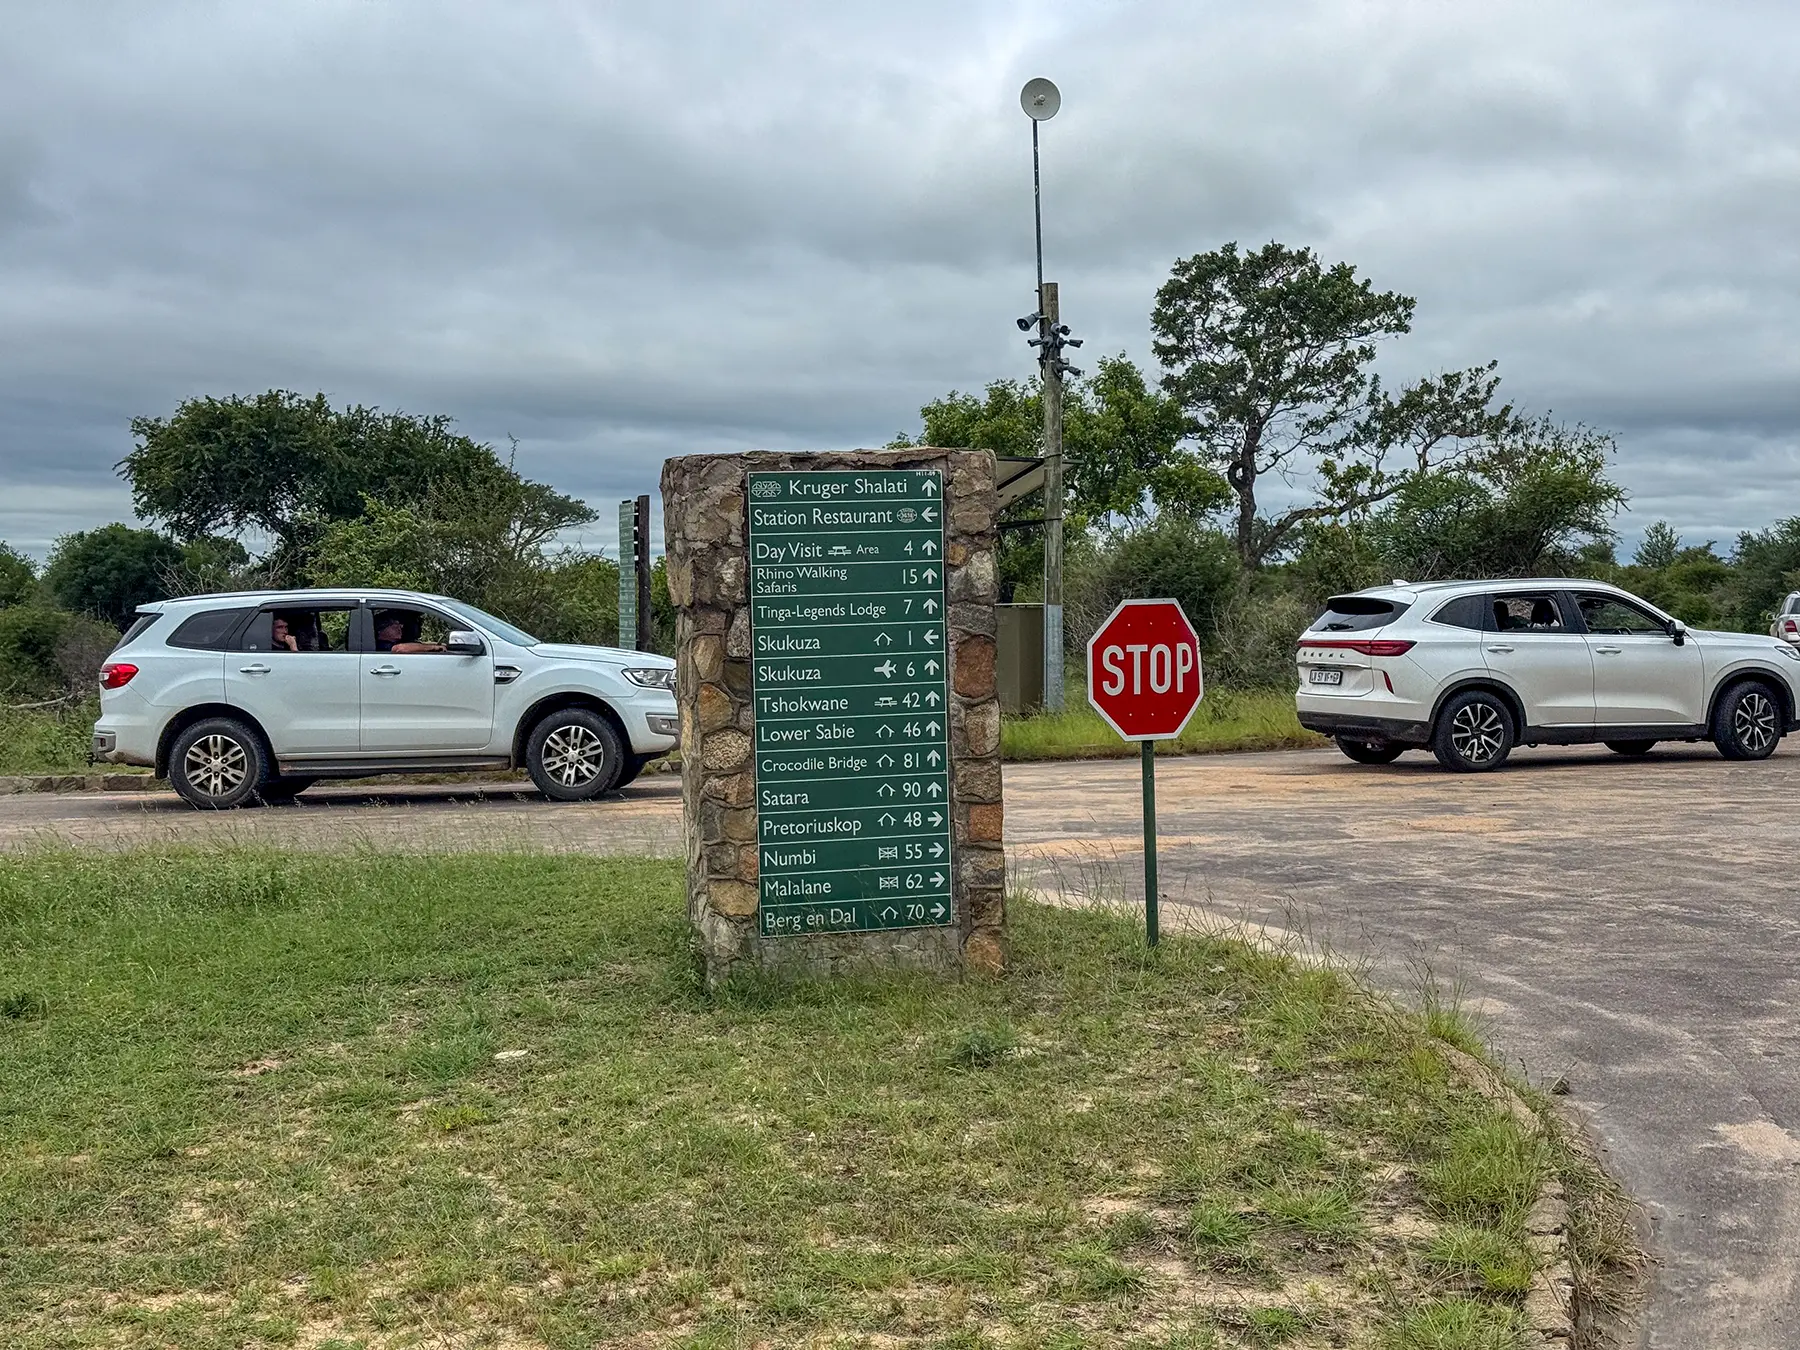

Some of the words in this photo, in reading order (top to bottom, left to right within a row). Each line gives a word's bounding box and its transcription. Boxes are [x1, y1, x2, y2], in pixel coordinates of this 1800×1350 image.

[790, 480, 848, 499] Kruger
[855, 478, 907, 493] Shalati
[755, 509, 806, 525] Station
[813, 508, 893, 524] Restaurant
[757, 543, 786, 563] Day
[788, 542, 822, 557] Visit
[857, 545, 879, 554] Area
[904, 541, 914, 555] 4
[757, 568, 794, 579] Rhino
[796, 567, 847, 580] Walking
[903, 569, 917, 584] 15
[757, 581, 797, 593] Safaris
[758, 604, 845, 621] Tinga-Legends
[850, 603, 886, 618] Lodge
[904, 600, 913, 614] 7
[758, 635, 821, 651] Skukuza
[759, 665, 822, 681] Skukuza
[907, 662, 915, 676] 6
[1102, 643, 1193, 697] STOP
[760, 696, 848, 712] Tshokwane
[902, 693, 920, 707] 42
[762, 727, 810, 741] Lower
[816, 724, 854, 739] Sabie
[903, 722, 921, 737] 46
[762, 758, 824, 771] Crocodile
[829, 756, 867, 771] Bridge
[904, 753, 919, 768] 81
[763, 790, 809, 805] Satara
[903, 782, 921, 797] 90
[764, 817, 861, 835] Pretoriuskop
[904, 812, 921, 827] 48
[765, 849, 815, 866] Numbi
[905, 844, 923, 859] 55
[766, 879, 831, 896] Malalane
[906, 874, 923, 889] 62
[766, 913, 801, 931] Berg
[807, 914, 823, 926] en
[831, 908, 855, 924] Dal
[907, 904, 924, 920] 70
